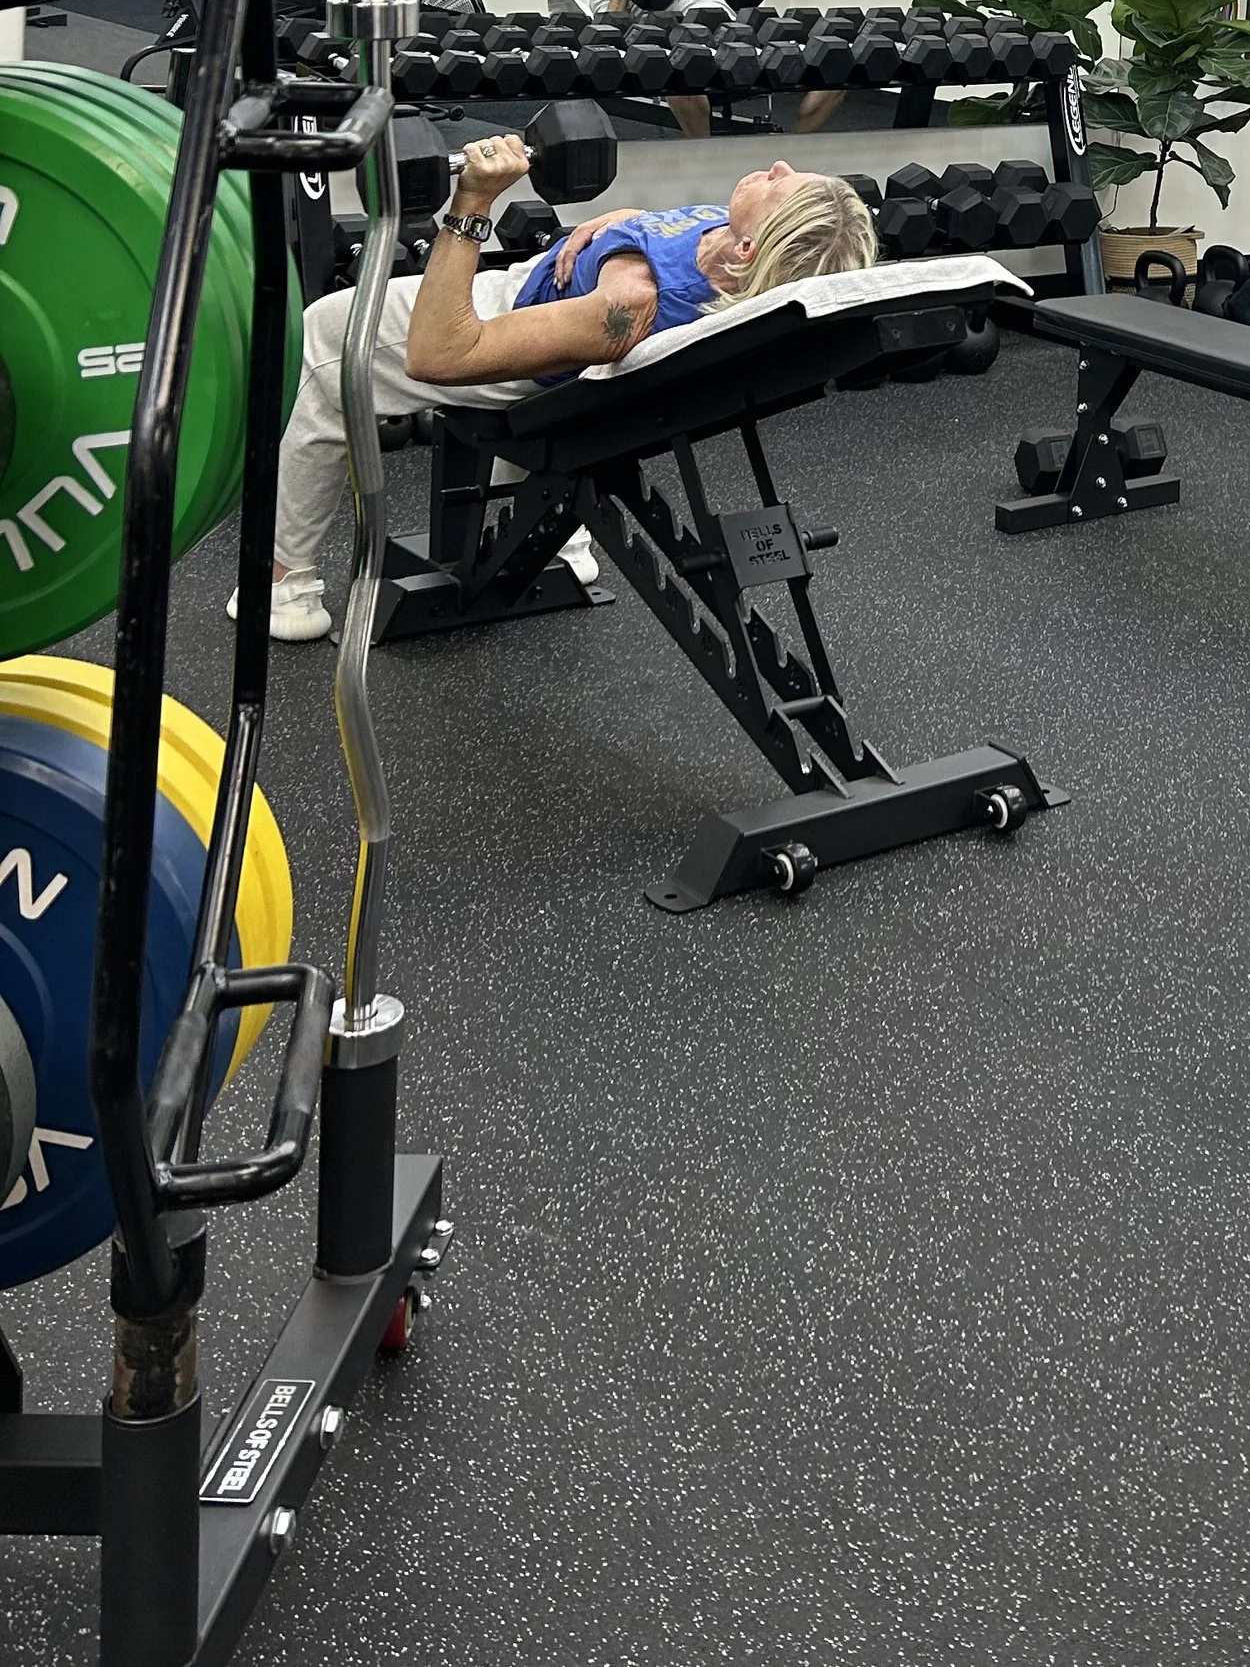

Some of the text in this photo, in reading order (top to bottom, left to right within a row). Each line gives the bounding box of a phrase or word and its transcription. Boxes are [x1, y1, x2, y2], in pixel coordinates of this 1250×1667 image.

[77, 342, 146, 378] 25
[756, 538, 774, 552] OF
[748, 549, 791, 566] STEEL
